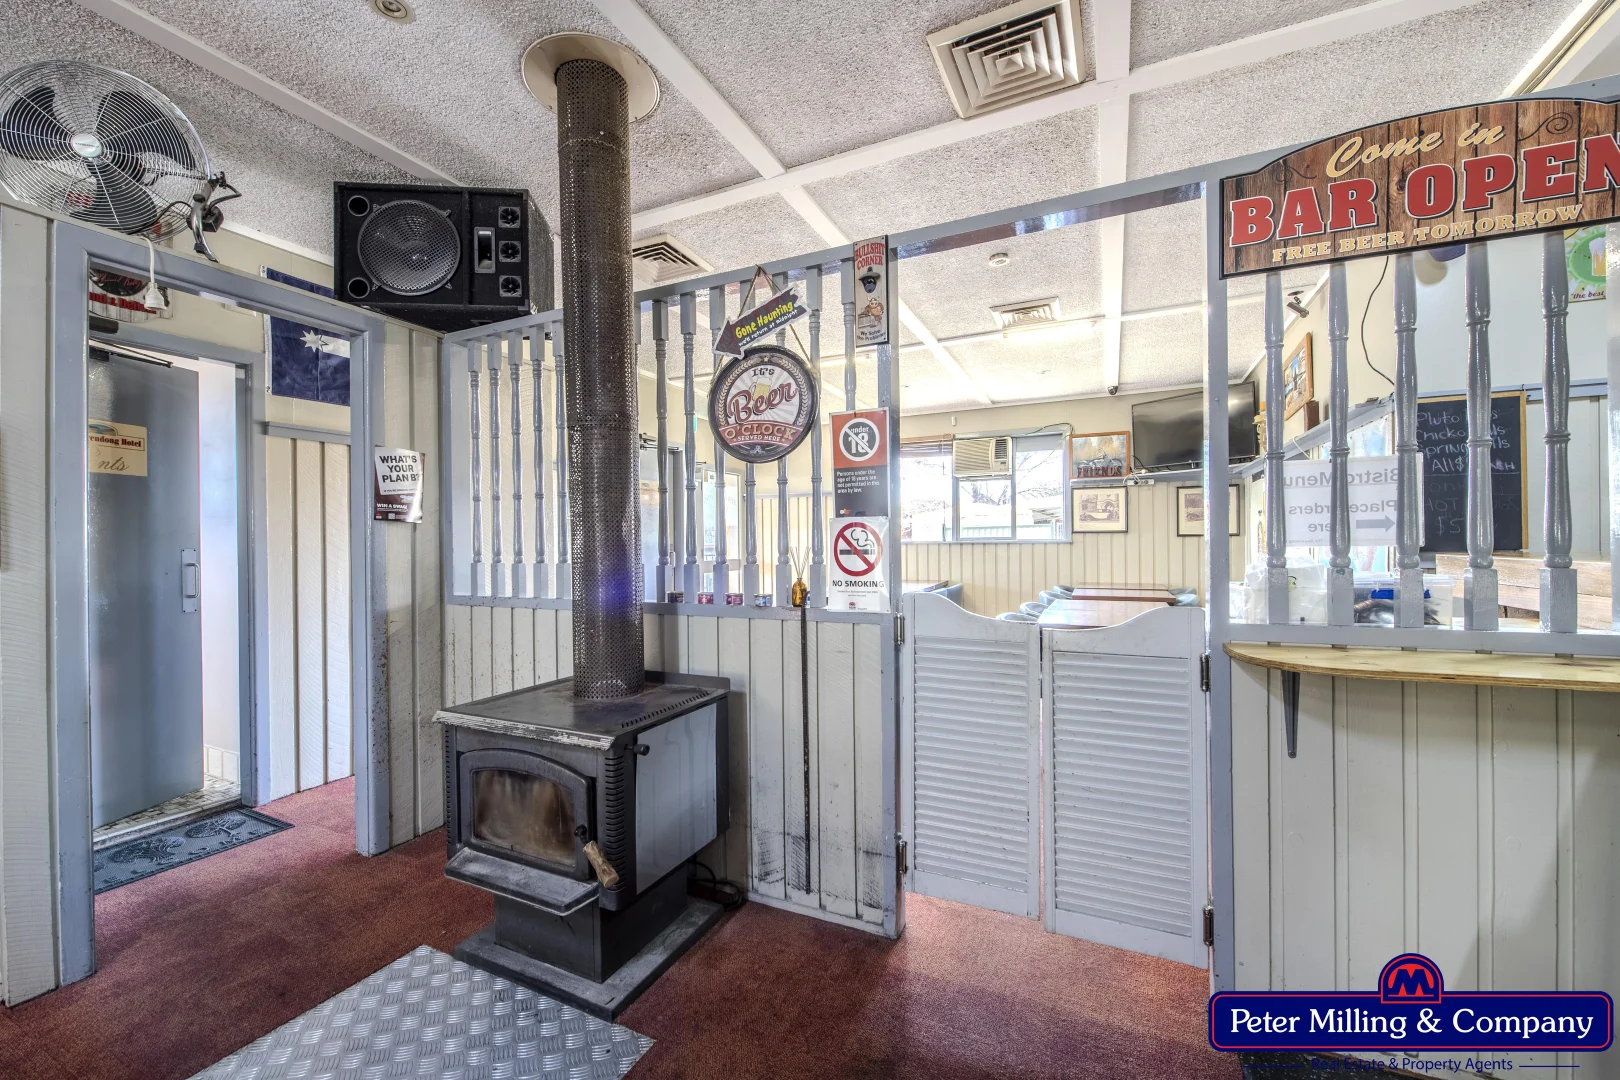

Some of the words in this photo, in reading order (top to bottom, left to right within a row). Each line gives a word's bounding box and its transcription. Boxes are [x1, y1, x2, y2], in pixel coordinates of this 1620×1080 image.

[1326, 132, 1443, 178] Come
[1458, 122, 1504, 147] in
[1229, 178, 1378, 248] BAR
[1405, 134, 1620, 220] OPEN
[1272, 241, 1332, 262] FREE
[1339, 231, 1405, 252] BEER
[1414, 204, 1583, 242] TOMORROW
[855, 242, 885, 262] BULLSHIT
[857, 255, 883, 270] CORNER
[736, 322, 757, 338] Gone
[757, 302, 794, 326] Haunting
[752, 327, 768, 338] return
[776, 309, 798, 324] midnight
[727, 382, 799, 424] Beer
[89, 436, 120, 446] endong
[122, 438, 142, 448] Hotel
[724, 423, 796, 440] O'CLOCK
[848, 432, 869, 454] 18
[379, 456, 418, 464] WHAT'S
[387, 465, 414, 473] YOUR
[382, 474, 409, 483] PLAN
